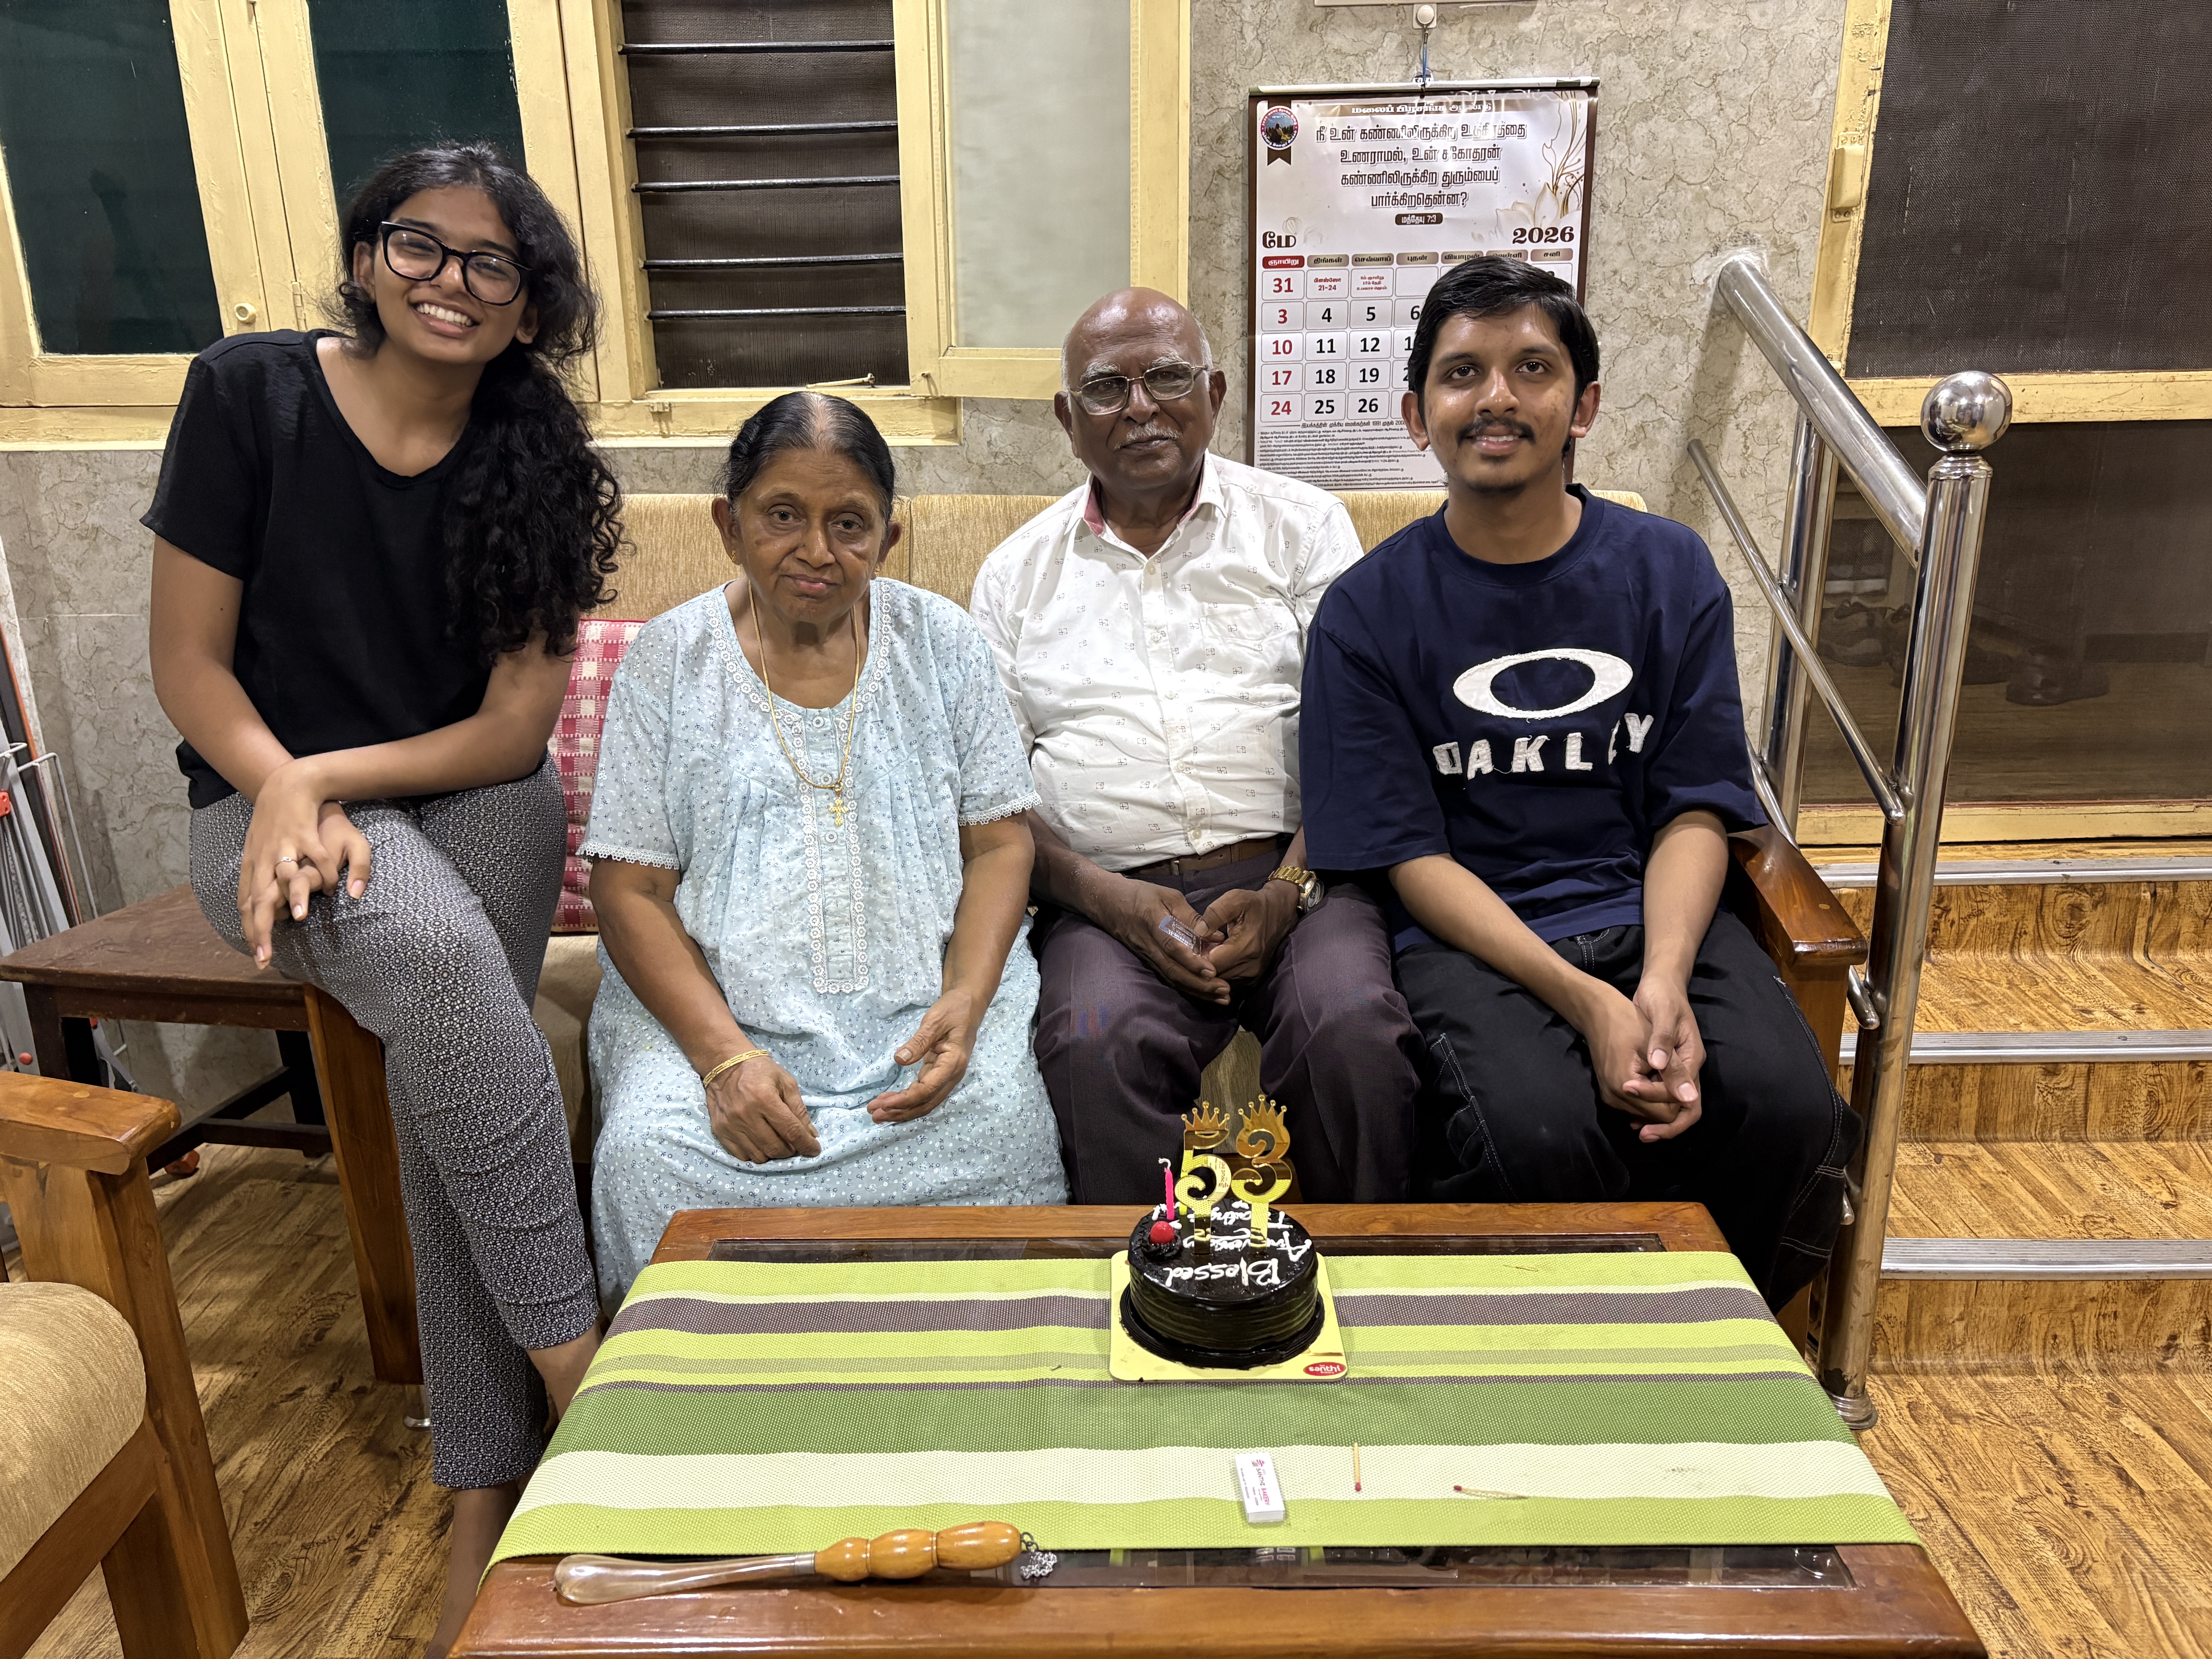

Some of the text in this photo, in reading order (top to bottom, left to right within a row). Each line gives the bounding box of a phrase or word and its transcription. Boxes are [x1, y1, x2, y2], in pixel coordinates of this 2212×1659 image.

[1352, 104, 1394, 113] மலைப்
[1316, 126, 1325, 141] நீ
[1330, 125, 1355, 140] உன்
[1340, 144, 1501, 164] உணராமல், உன் சகோதரன்
[1341, 166, 1499, 187] கண்ணிலிருக்கிற துரும்பைப்
[1371, 191, 1468, 208] பார்க்கிறதென்ன?
[1401, 214, 1436, 224] மத்தேயு 7:3
[1262, 231, 1297, 248] மே
[1512, 226, 1574, 244] 2026
[1268, 258, 1299, 266] ஞாயிறு
[1273, 277, 1293, 293] 31
[1278, 309, 1288, 324] 3
[1322, 308, 1332, 323] 4
[1366, 307, 1376, 321] 5
[1410, 305, 1420, 320] 6
[1272, 340, 1293, 355] 10
[1316, 339, 1336, 353] 11
[1360, 337, 1380, 352] 12
[1405, 336, 1413, 350] 1
[1272, 370, 1292, 385] 17
[1316, 369, 1335, 384] 18
[1359, 368, 1379, 383] 19
[1271, 401, 1291, 416] 24
[1314, 399, 1334, 414] 25
[1358, 398, 1378, 413] 26
[1175, 1128, 1293, 1206] 53
[1163, 1257, 1281, 1287] Blessed
[1256, 1468, 1270, 1506] SANTHI BAKERY
